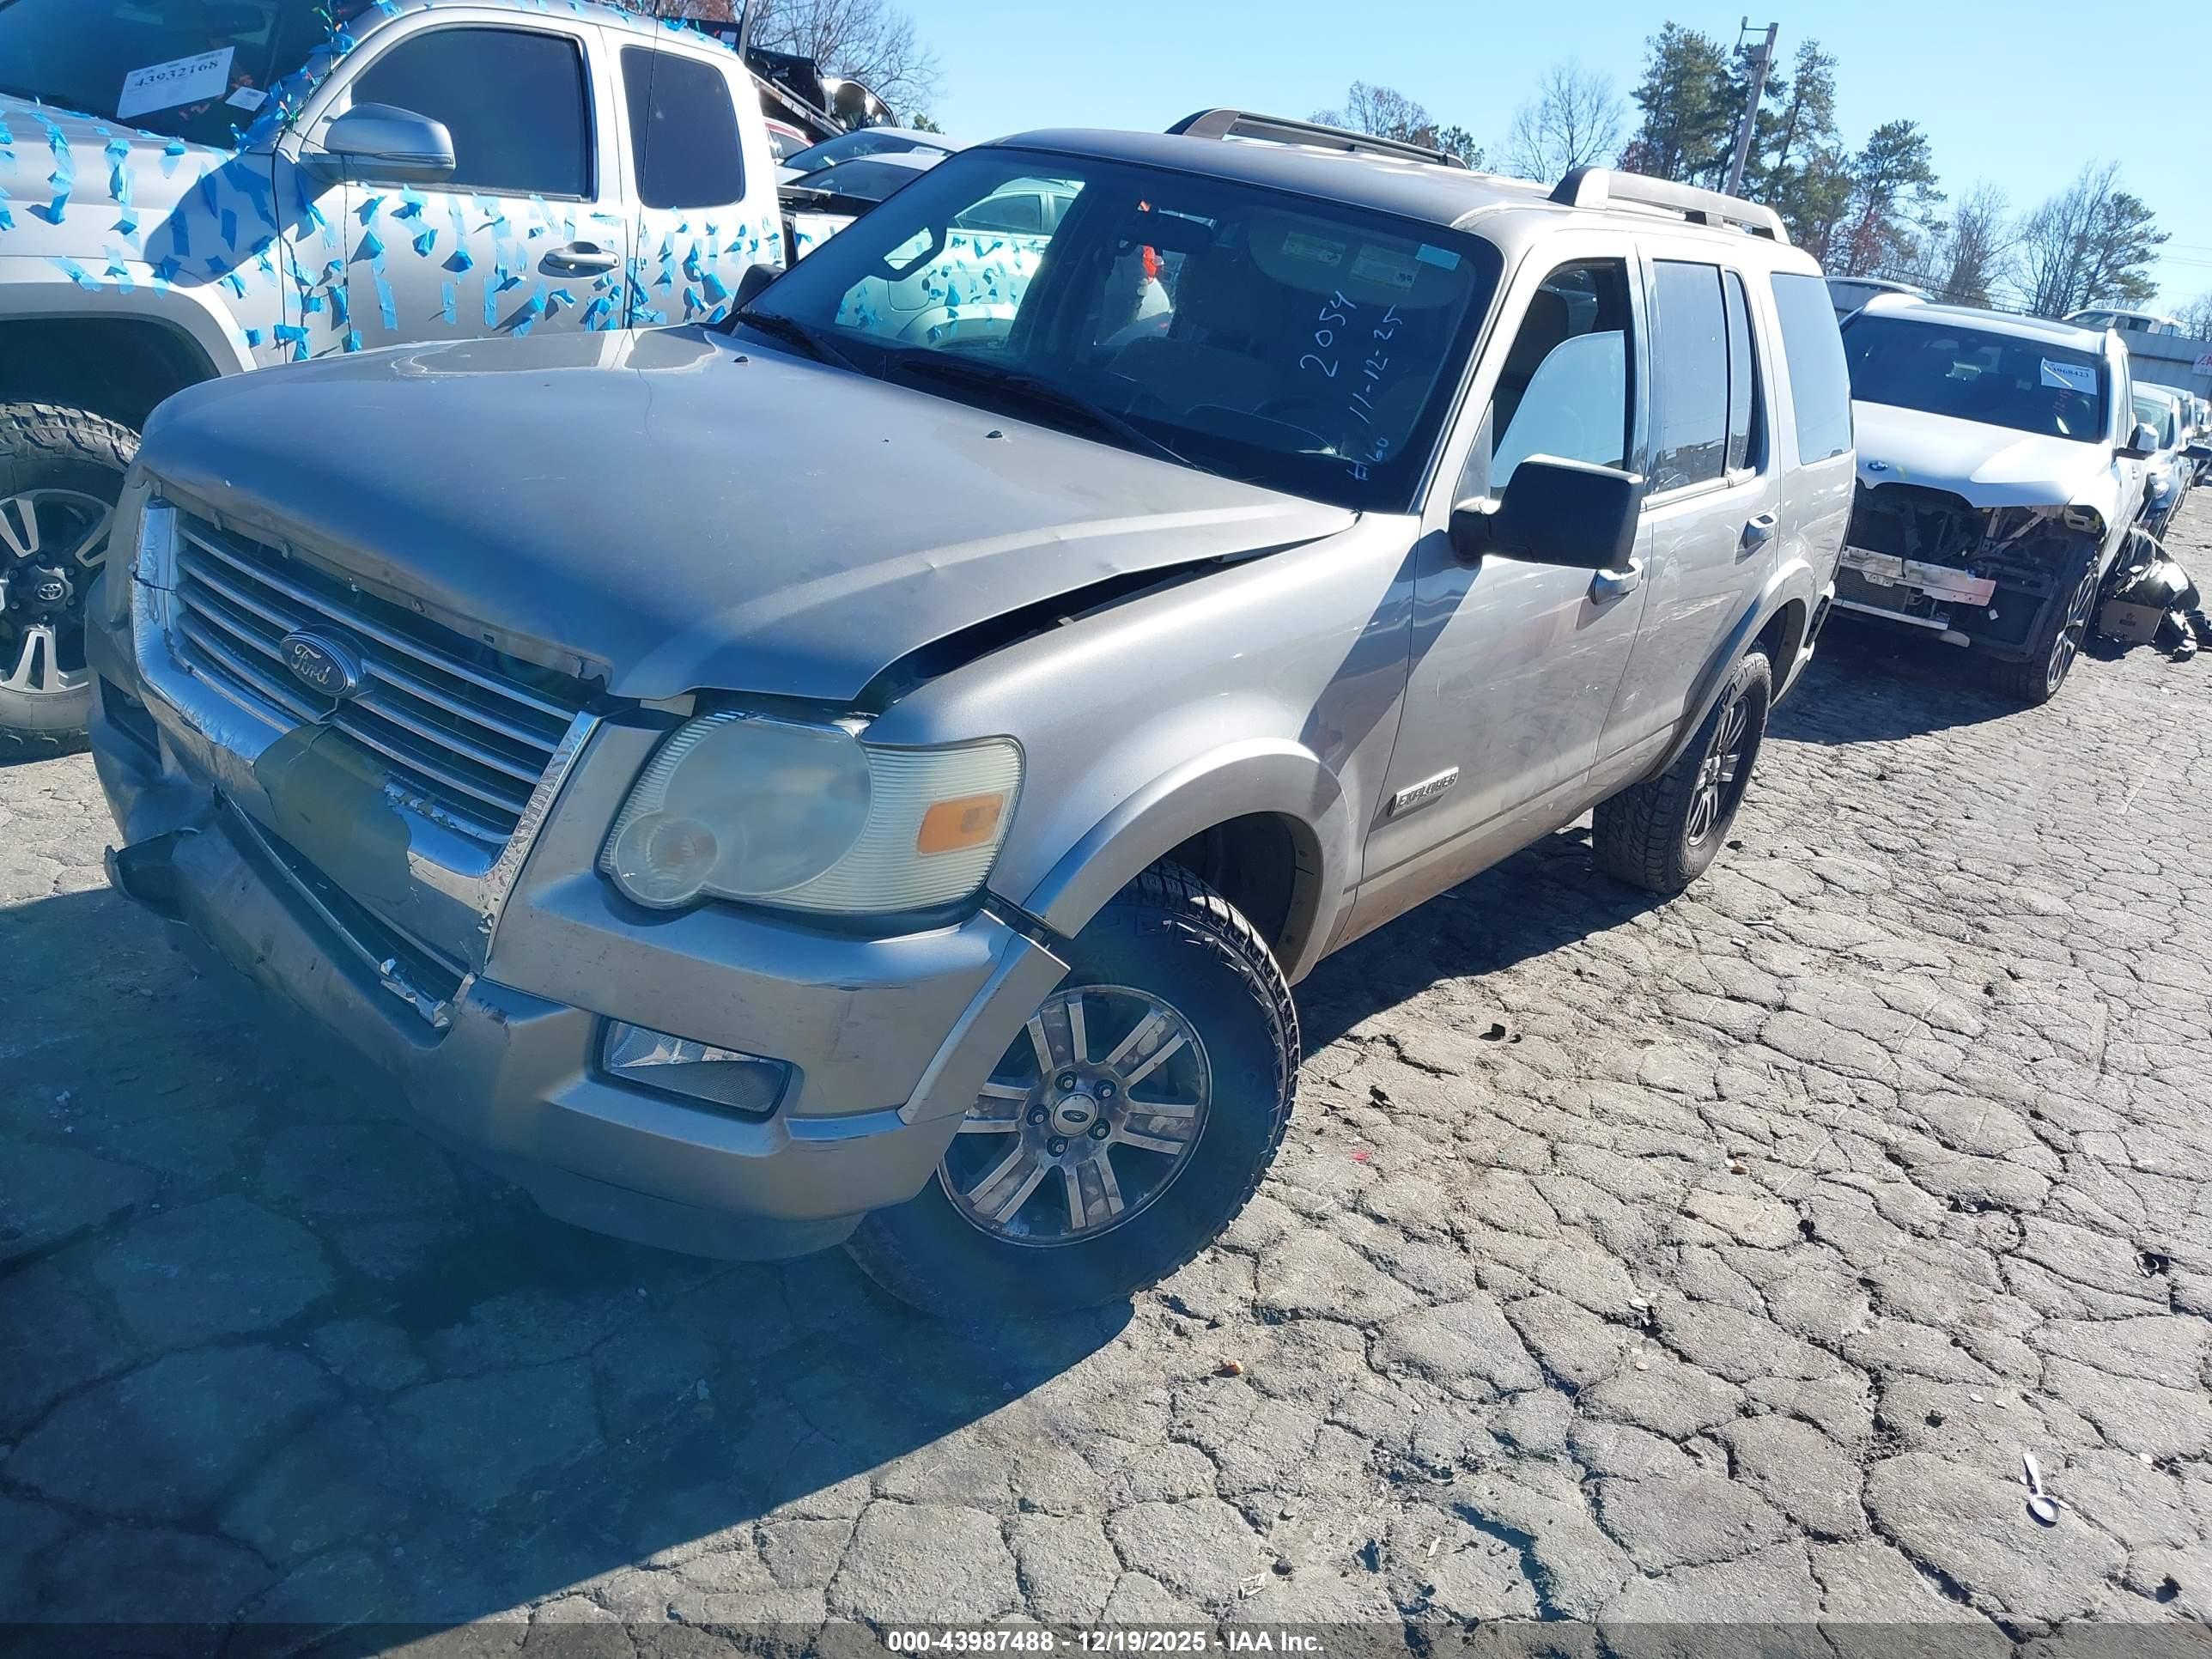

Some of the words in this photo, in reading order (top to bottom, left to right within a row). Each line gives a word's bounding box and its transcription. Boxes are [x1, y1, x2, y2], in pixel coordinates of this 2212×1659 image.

[134, 60, 219, 88] 43932168
[1299, 290, 1358, 378] 2054
[1348, 303, 1402, 425] 11-12-25
[291, 643, 331, 685] Ford
[1395, 772, 1458, 808] EXPLORER
